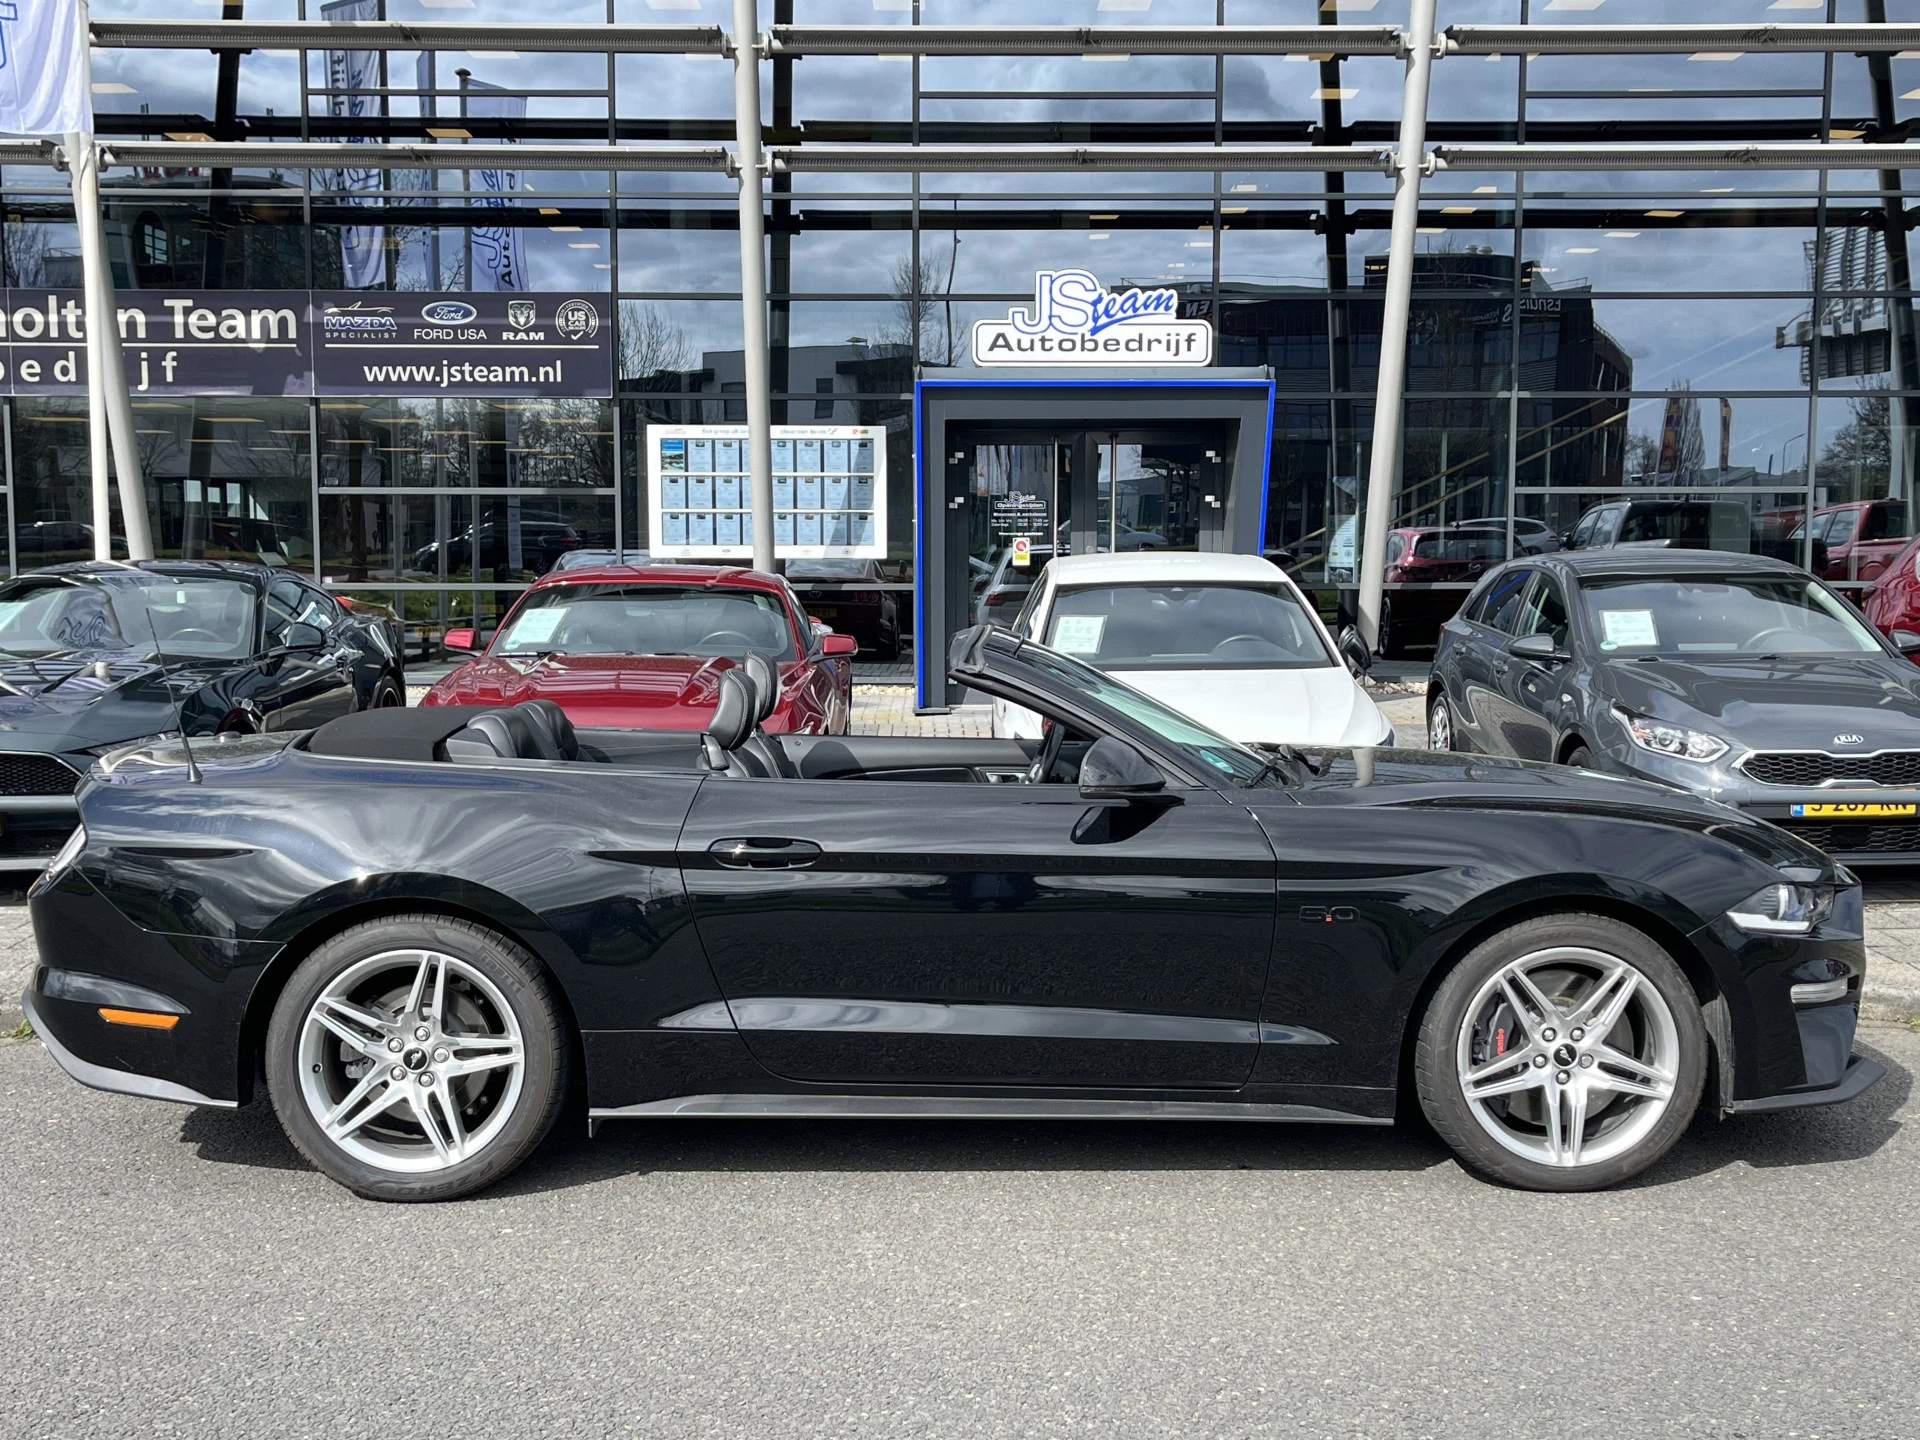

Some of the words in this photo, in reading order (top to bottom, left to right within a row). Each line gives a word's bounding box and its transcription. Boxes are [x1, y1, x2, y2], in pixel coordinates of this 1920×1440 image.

[1012, 273, 1097, 335] JS
[1091, 290, 1174, 326] team
[164, 299, 297, 339] Team
[433, 306, 465, 321] Ford
[567, 311, 586, 321] US
[324, 316, 398, 330] MAZDA
[413, 329, 454, 340] FORD
[458, 329, 487, 340] USA
[502, 332, 545, 341] RAM
[988, 333, 1197, 357] Autobedrijf
[363, 359, 563, 388] www.jsteam.nl
[1838, 734, 1862, 744] KIA
[1299, 905, 1360, 923] 5.0
